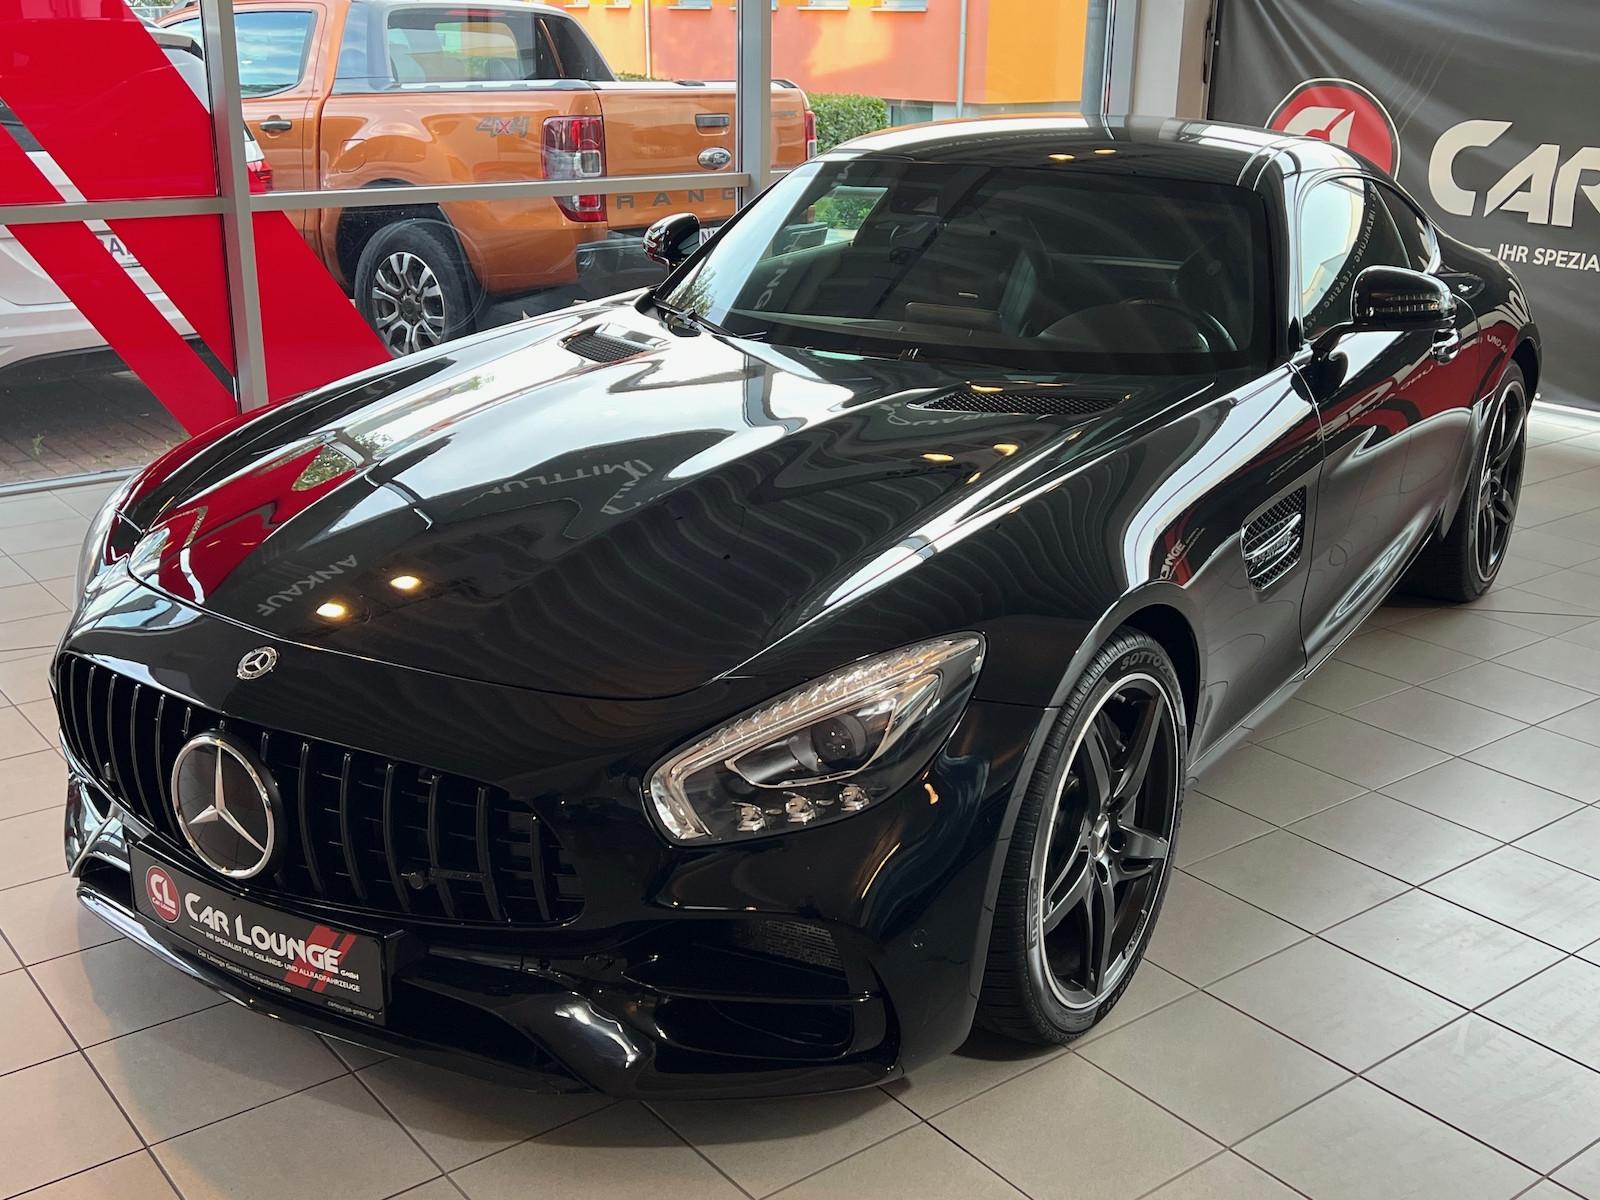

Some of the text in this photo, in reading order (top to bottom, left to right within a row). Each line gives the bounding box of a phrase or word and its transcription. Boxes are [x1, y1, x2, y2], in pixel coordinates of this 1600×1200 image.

[616, 189, 736, 209] RANG
[1497, 242, 1528, 267] IHR
[256, 554, 358, 616] ANKAUF
[150, 873, 177, 909] CL
[184, 892, 230, 936] CAR
[234, 914, 342, 974] LOUNGE
[214, 935, 242, 953] SPEZIALIST
[284, 962, 298, 973] UND
[299, 968, 361, 993] ALLRADFAHRZEUGE
